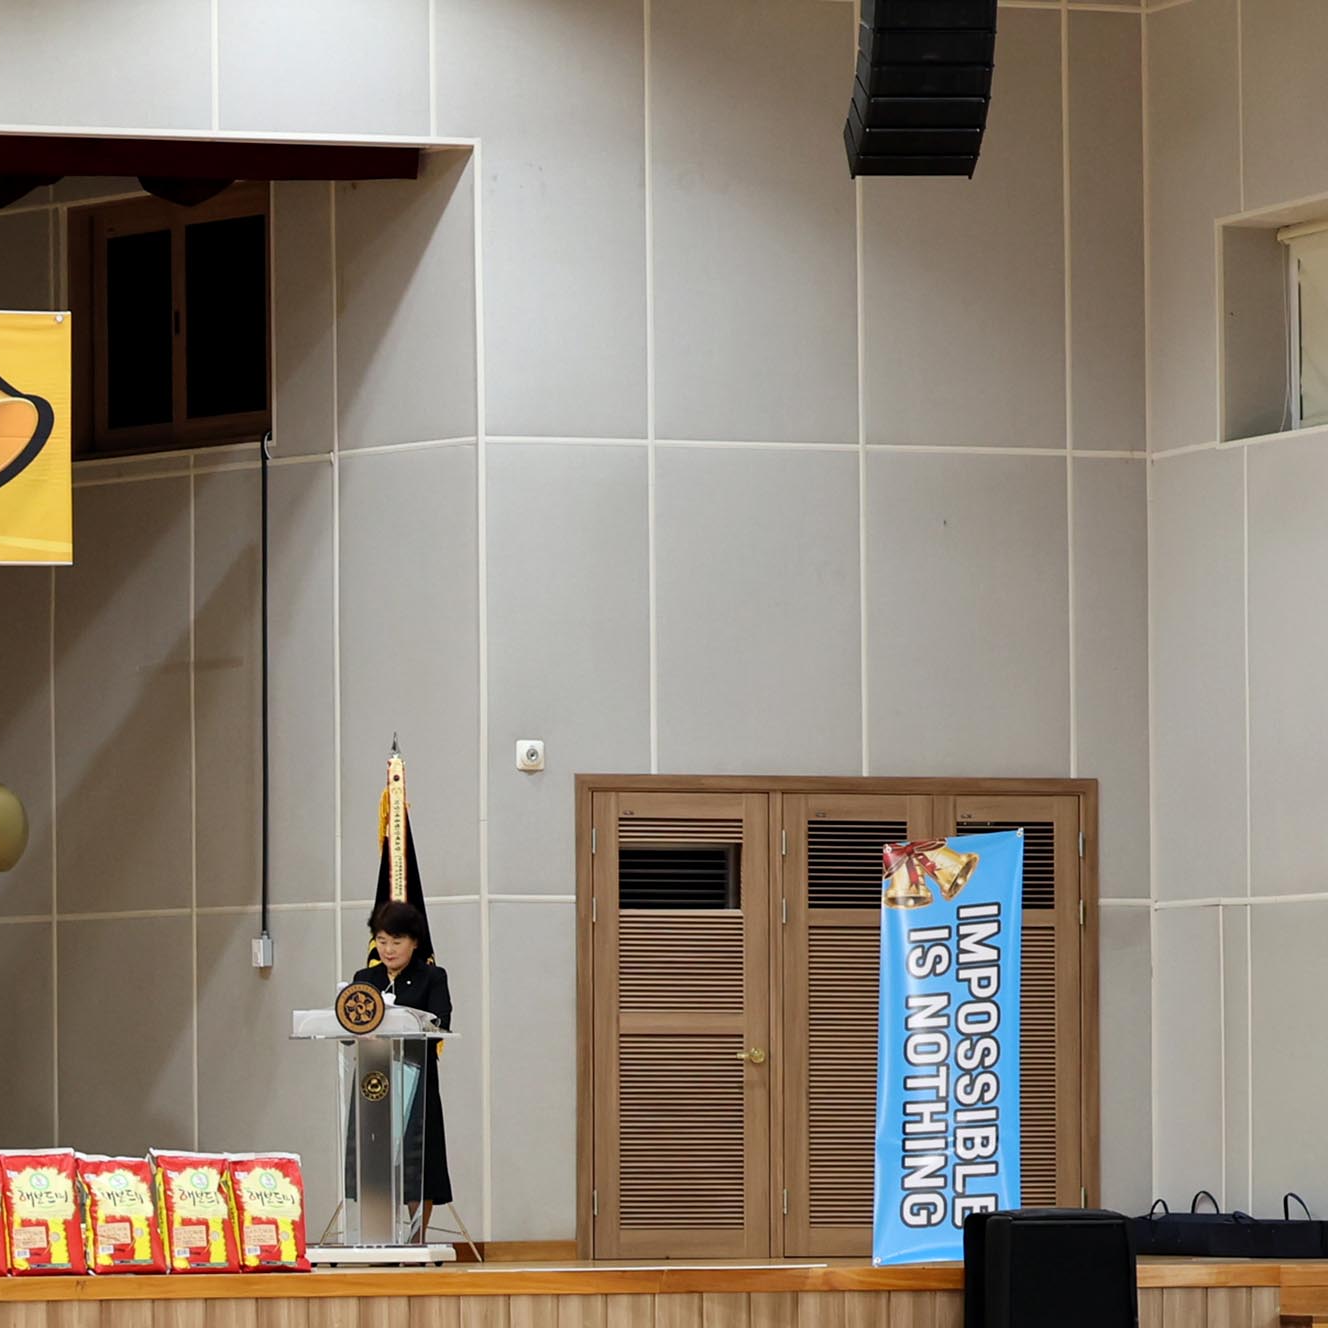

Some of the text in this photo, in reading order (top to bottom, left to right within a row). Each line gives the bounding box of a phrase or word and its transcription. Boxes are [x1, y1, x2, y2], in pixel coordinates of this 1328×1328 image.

[900, 926, 950, 1228] IS NOTHING
[953, 902, 1000, 1228] IMPOSSIBLE
